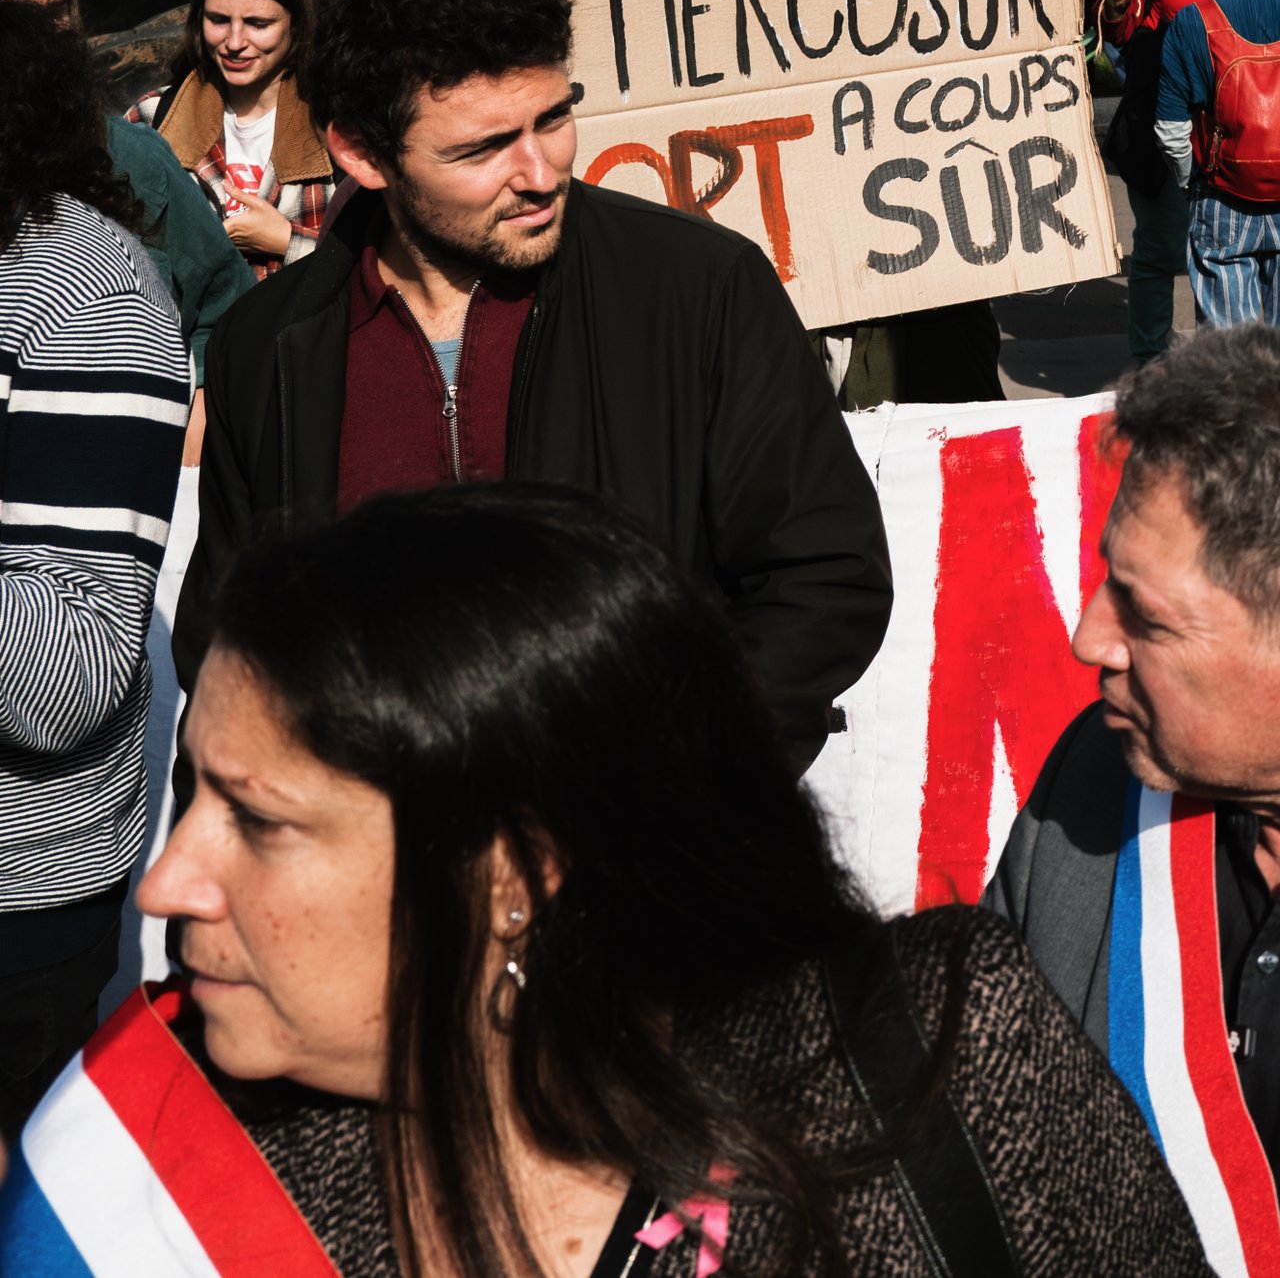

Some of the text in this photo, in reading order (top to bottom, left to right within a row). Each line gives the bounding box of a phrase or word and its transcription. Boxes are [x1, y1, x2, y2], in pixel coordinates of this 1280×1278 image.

[833, 55, 1080, 156] A COUPS
[862, 136, 1088, 275] SÛR
